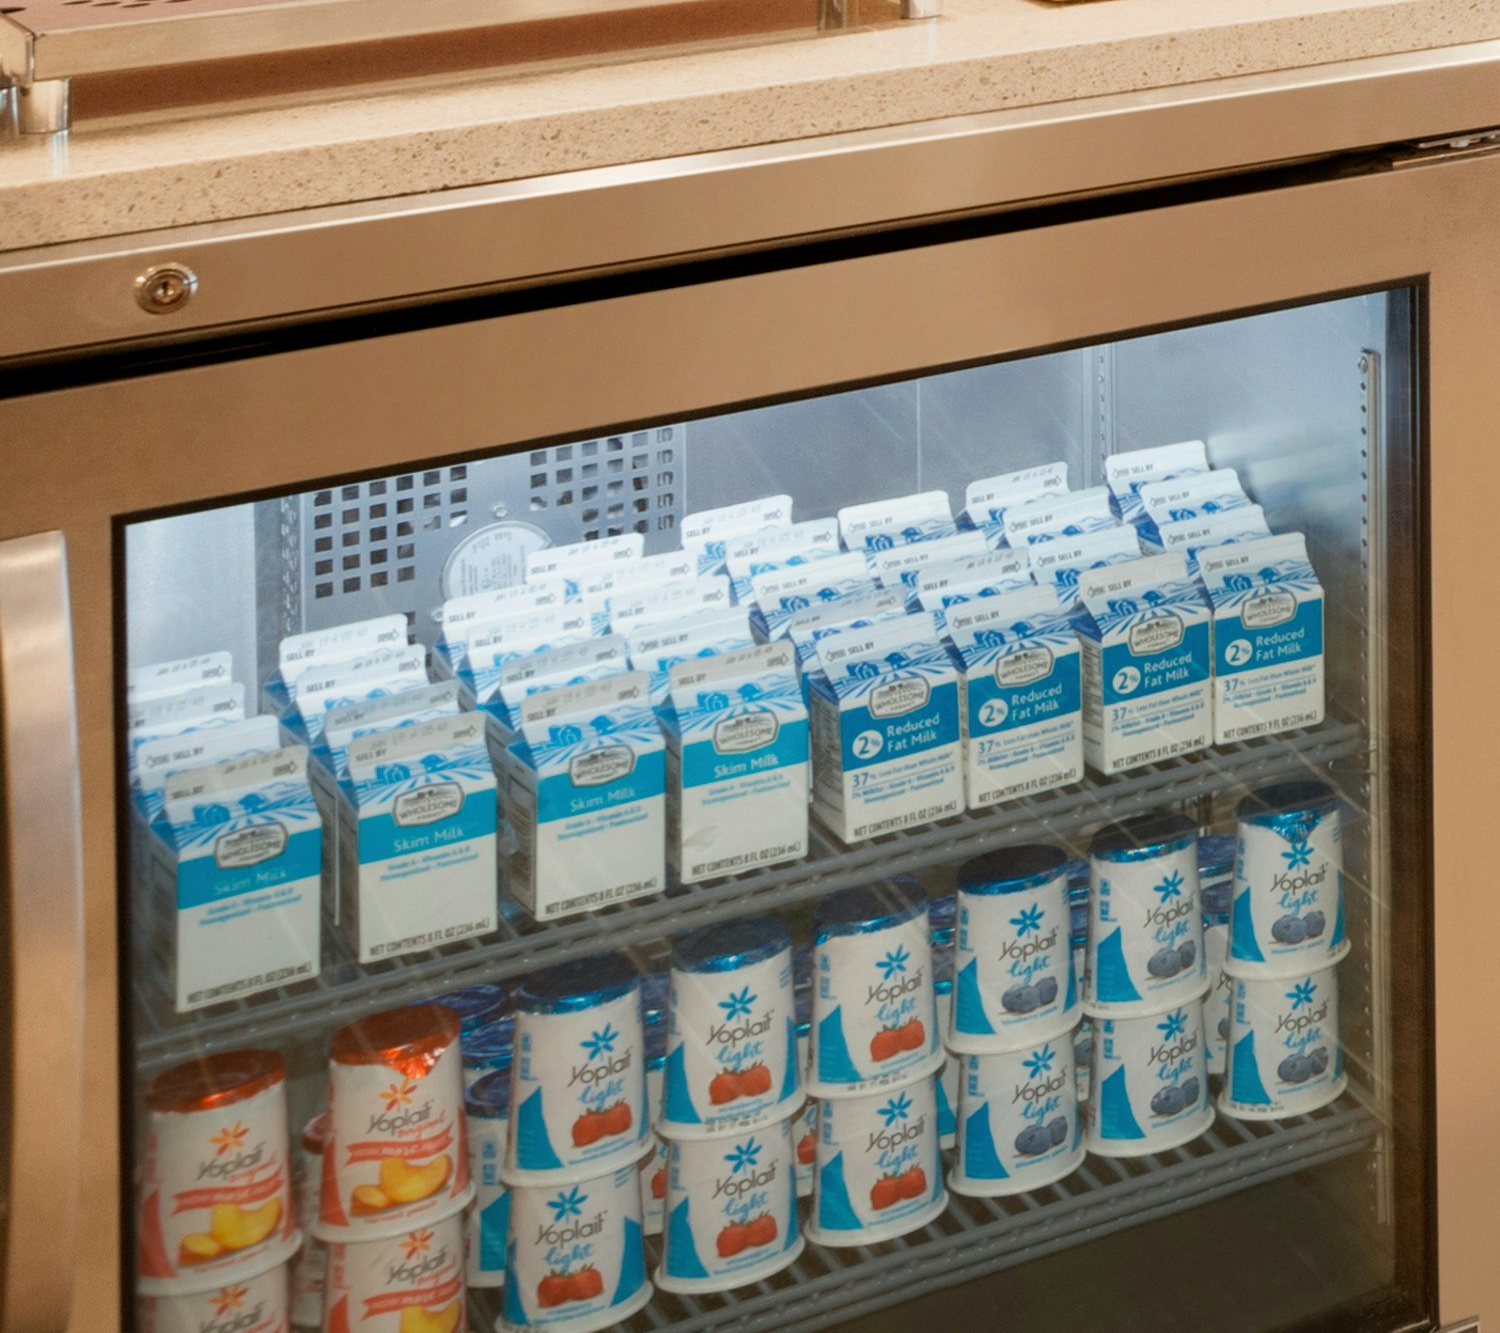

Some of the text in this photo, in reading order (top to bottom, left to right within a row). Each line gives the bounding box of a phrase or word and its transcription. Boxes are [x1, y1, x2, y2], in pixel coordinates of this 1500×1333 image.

[1226, 556, 1250, 568] SELL BY
[924, 579, 948, 591] SELL BY
[1108, 580, 1132, 593] SELL BY
[975, 611, 1000, 623] SELL BY
[848, 642, 874, 654] SELL BY
[1255, 628, 1305, 646] Reduced
[1256, 641, 1301, 661] Fat Milk
[1144, 653, 1193, 674] Reduced
[1144, 668, 1189, 688] Fat Milk
[1011, 684, 1063, 705] Reduced
[1012, 700, 1060, 720] Fat Milk
[887, 713, 940, 737] Reduced
[1223, 726, 1235, 739] NET
[888, 730, 937, 753] Fat Milk
[714, 753, 779, 778] Skim Milk
[1112, 755, 1125, 769] NET
[571, 788, 636, 812] Skim Milk
[979, 790, 991, 803] NET
[992, 783, 1024, 800] CONTENTS
[854, 824, 868, 837] NET
[869, 813, 902, 833] CONTENTS
[394, 827, 464, 852] Skim Milk
[1270, 861, 1329, 895] Yoplait
[1277, 889, 1319, 917] light
[998, 925, 1060, 963] Yoplait
[1007, 955, 1050, 986] light
[864, 967, 924, 1006] Yoplait
[874, 997, 918, 1026] light
[1275, 998, 1329, 1033] Yoplait
[706, 1009, 775, 1047] Yoplait
[1283, 1027, 1321, 1055] light
[568, 1047, 633, 1087] Yoplait
[715, 1040, 765, 1075] light
[1156, 1056, 1194, 1084] light
[577, 1079, 626, 1109] light
[1011, 1065, 1068, 1104] Yoplait
[1021, 1095, 1061, 1125] light
[864, 1114, 927, 1153] Yoplait
[875, 1144, 919, 1176] light
[712, 1159, 779, 1200] Yoplait
[721, 1190, 769, 1223] light
[535, 1211, 608, 1248] Yoplait
[543, 1242, 595, 1273] light
